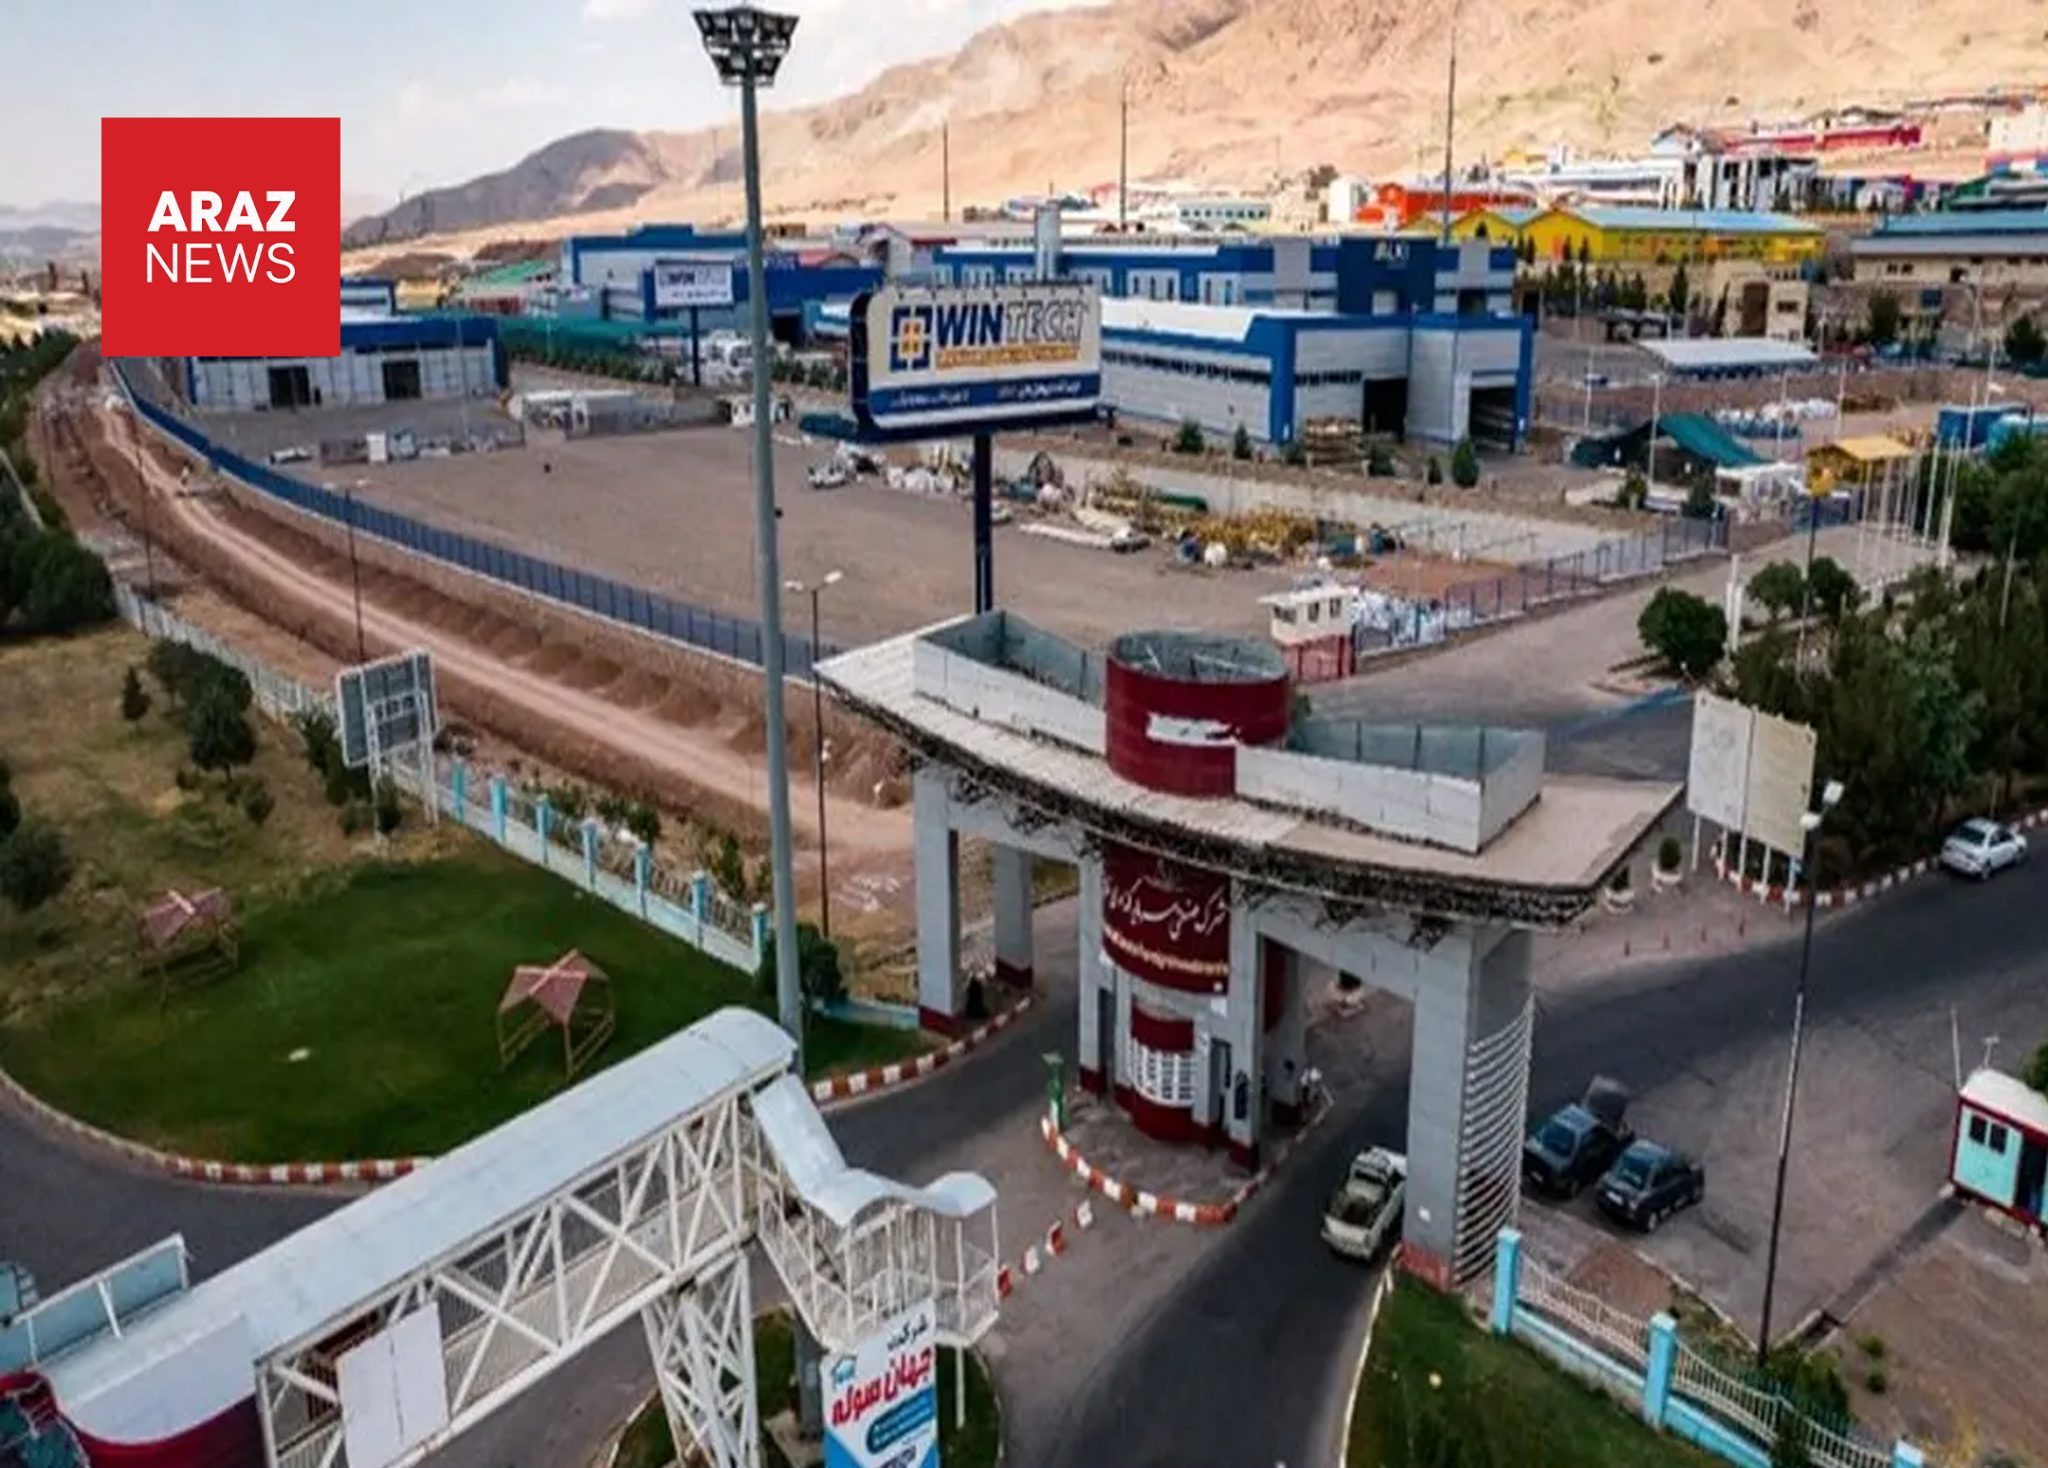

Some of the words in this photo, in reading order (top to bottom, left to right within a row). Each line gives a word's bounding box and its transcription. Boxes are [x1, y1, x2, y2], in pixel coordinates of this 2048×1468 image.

[936, 300, 1085, 346] WINTECH
[884, 1346, 932, 1400] جهان
[832, 1376, 882, 1427] سوله
